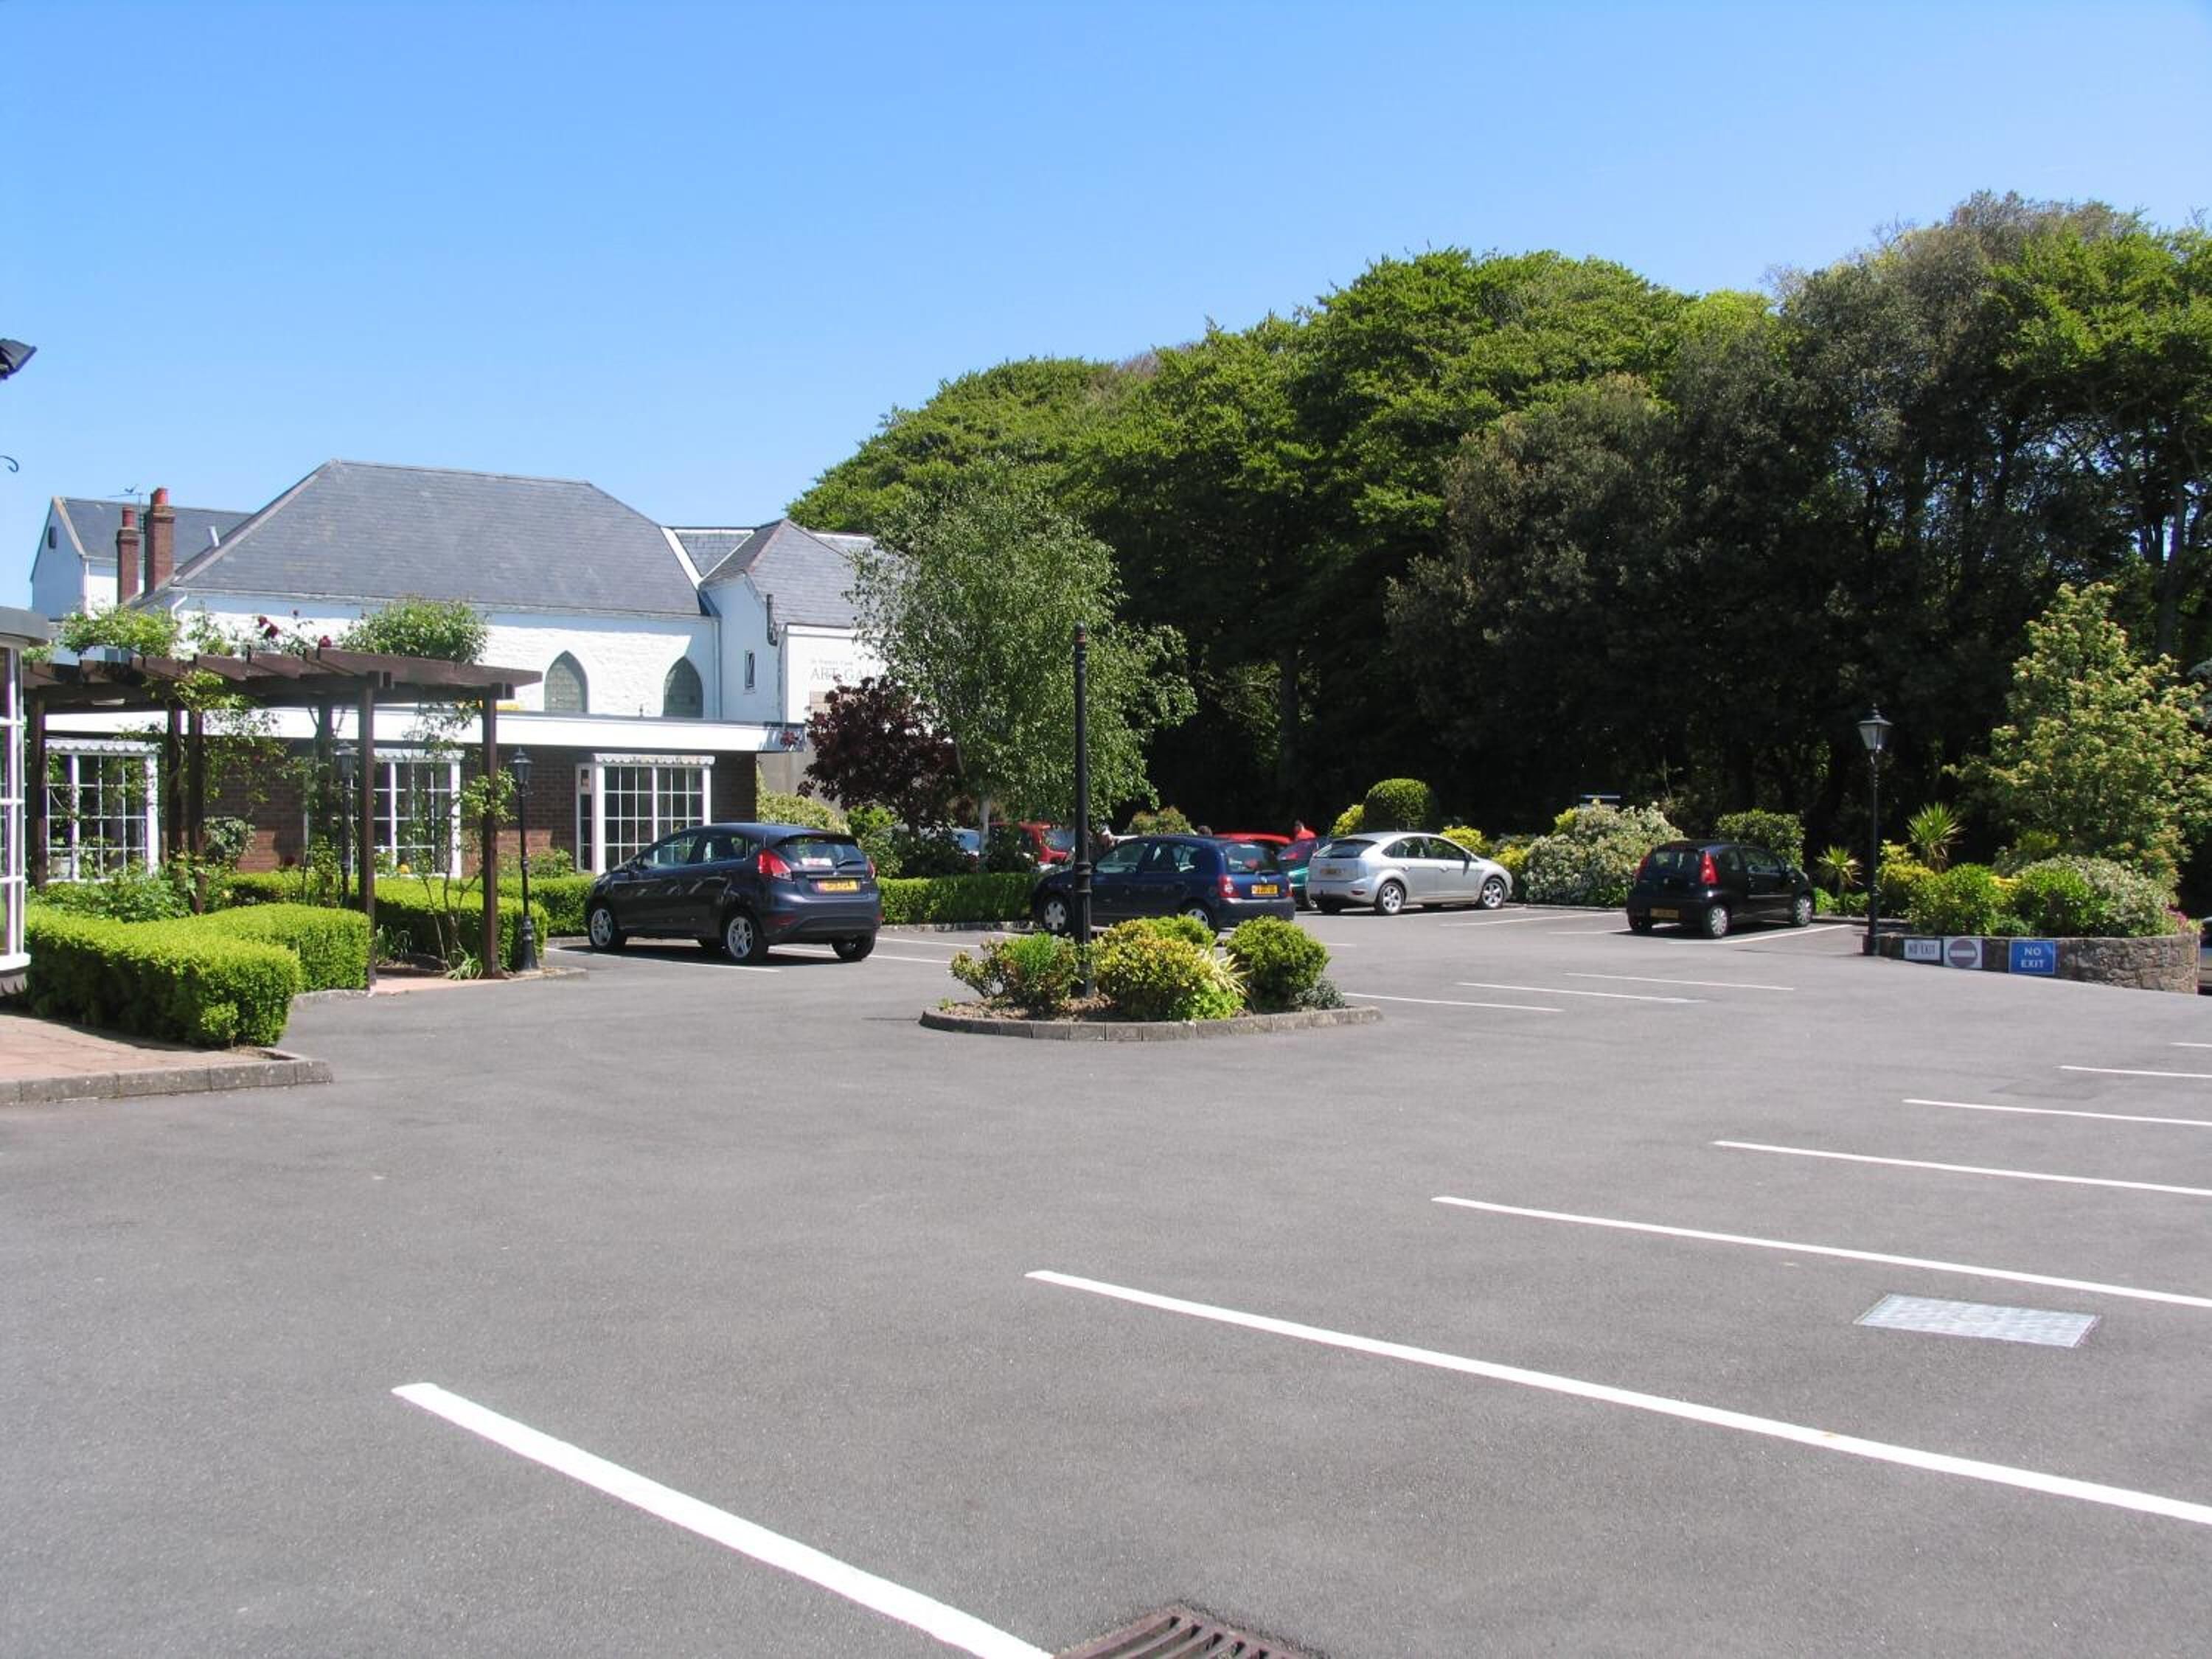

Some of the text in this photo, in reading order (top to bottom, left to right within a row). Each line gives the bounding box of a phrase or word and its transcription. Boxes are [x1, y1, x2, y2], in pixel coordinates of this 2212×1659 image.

[1921, 944, 1935, 955] EXIT
[2024, 946, 2042, 956] NO
[2021, 959, 2045, 968] EXIT
